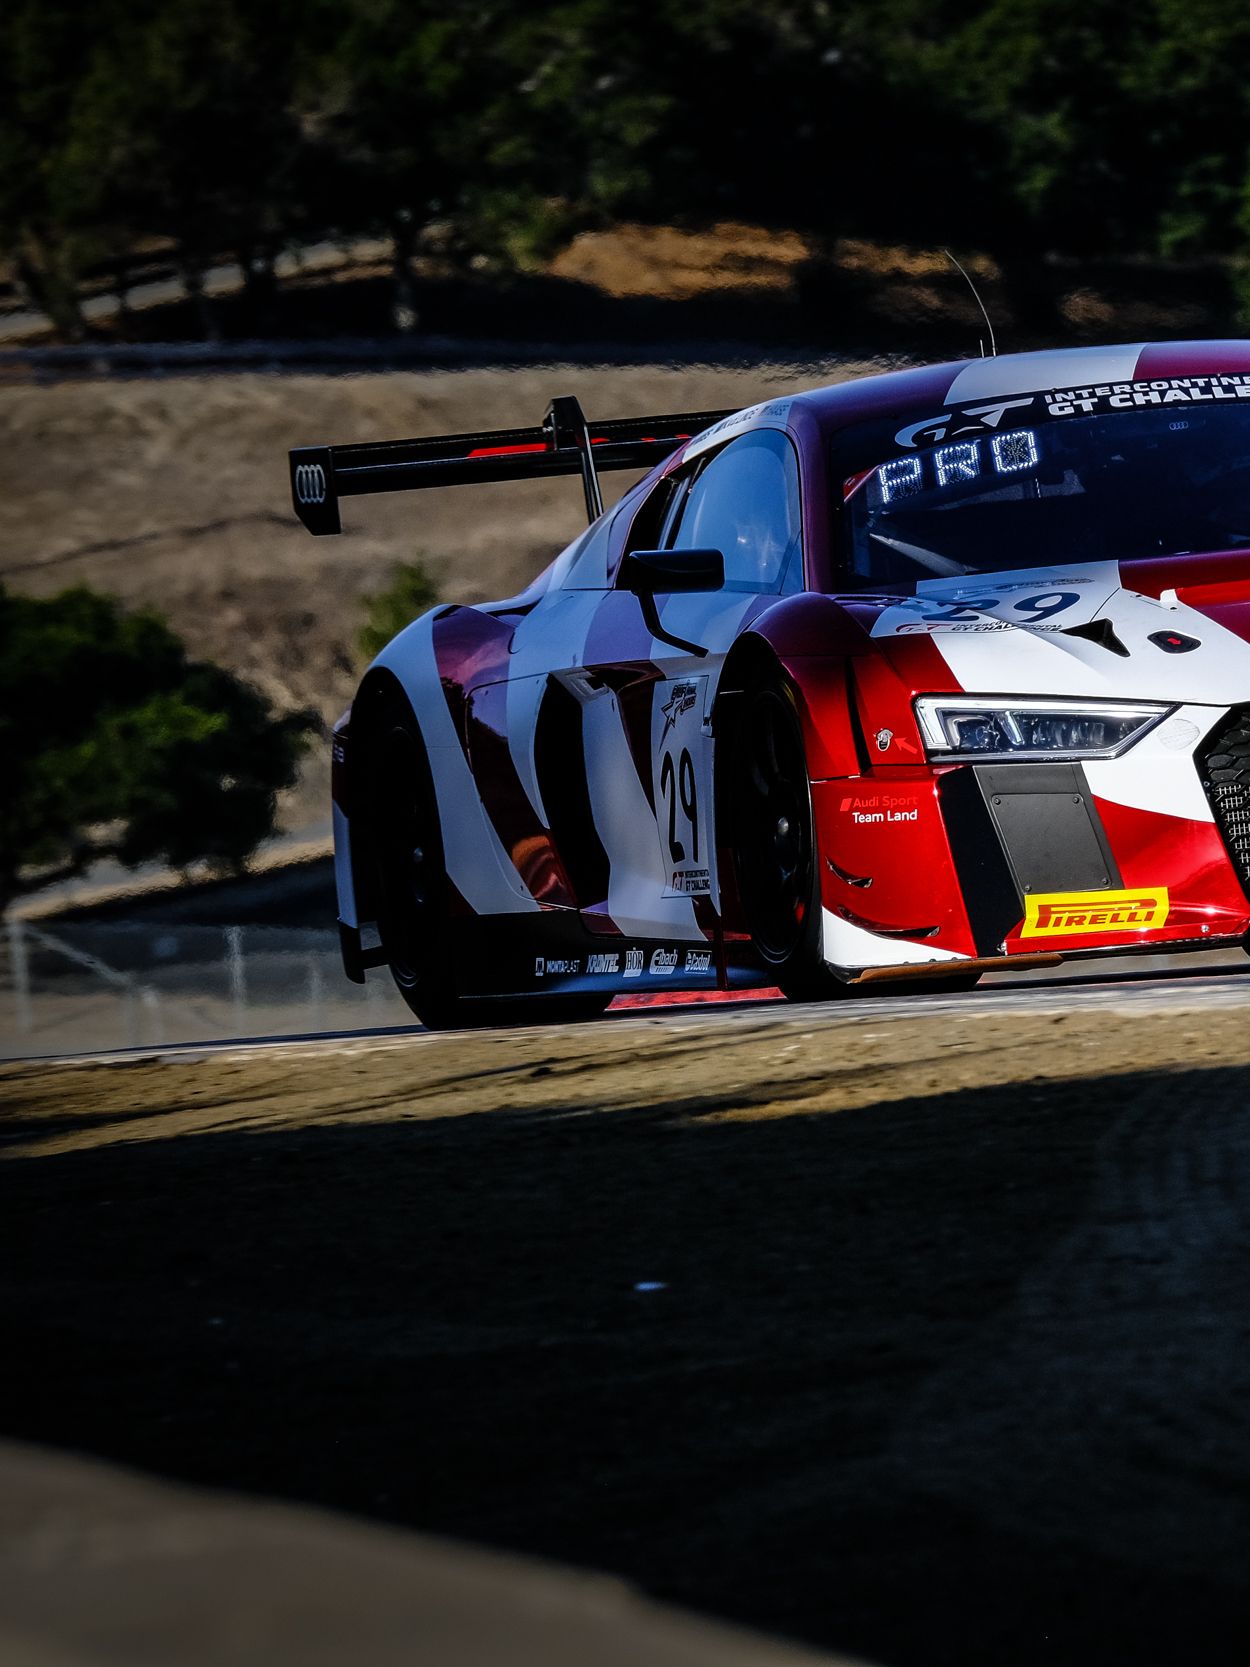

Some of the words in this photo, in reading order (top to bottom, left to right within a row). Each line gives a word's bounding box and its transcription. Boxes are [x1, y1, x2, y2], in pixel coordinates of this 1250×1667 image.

[1048, 398, 1099, 416] GT
[879, 431, 1039, 504] PRO
[921, 591, 1081, 622] 29
[660, 747, 699, 865] 29
[852, 811, 884, 823] Team
[887, 809, 918, 822] Land
[853, 797, 879, 808] Audi
[882, 796, 918, 809] Sport
[1035, 898, 1158, 929] PIRELLI
